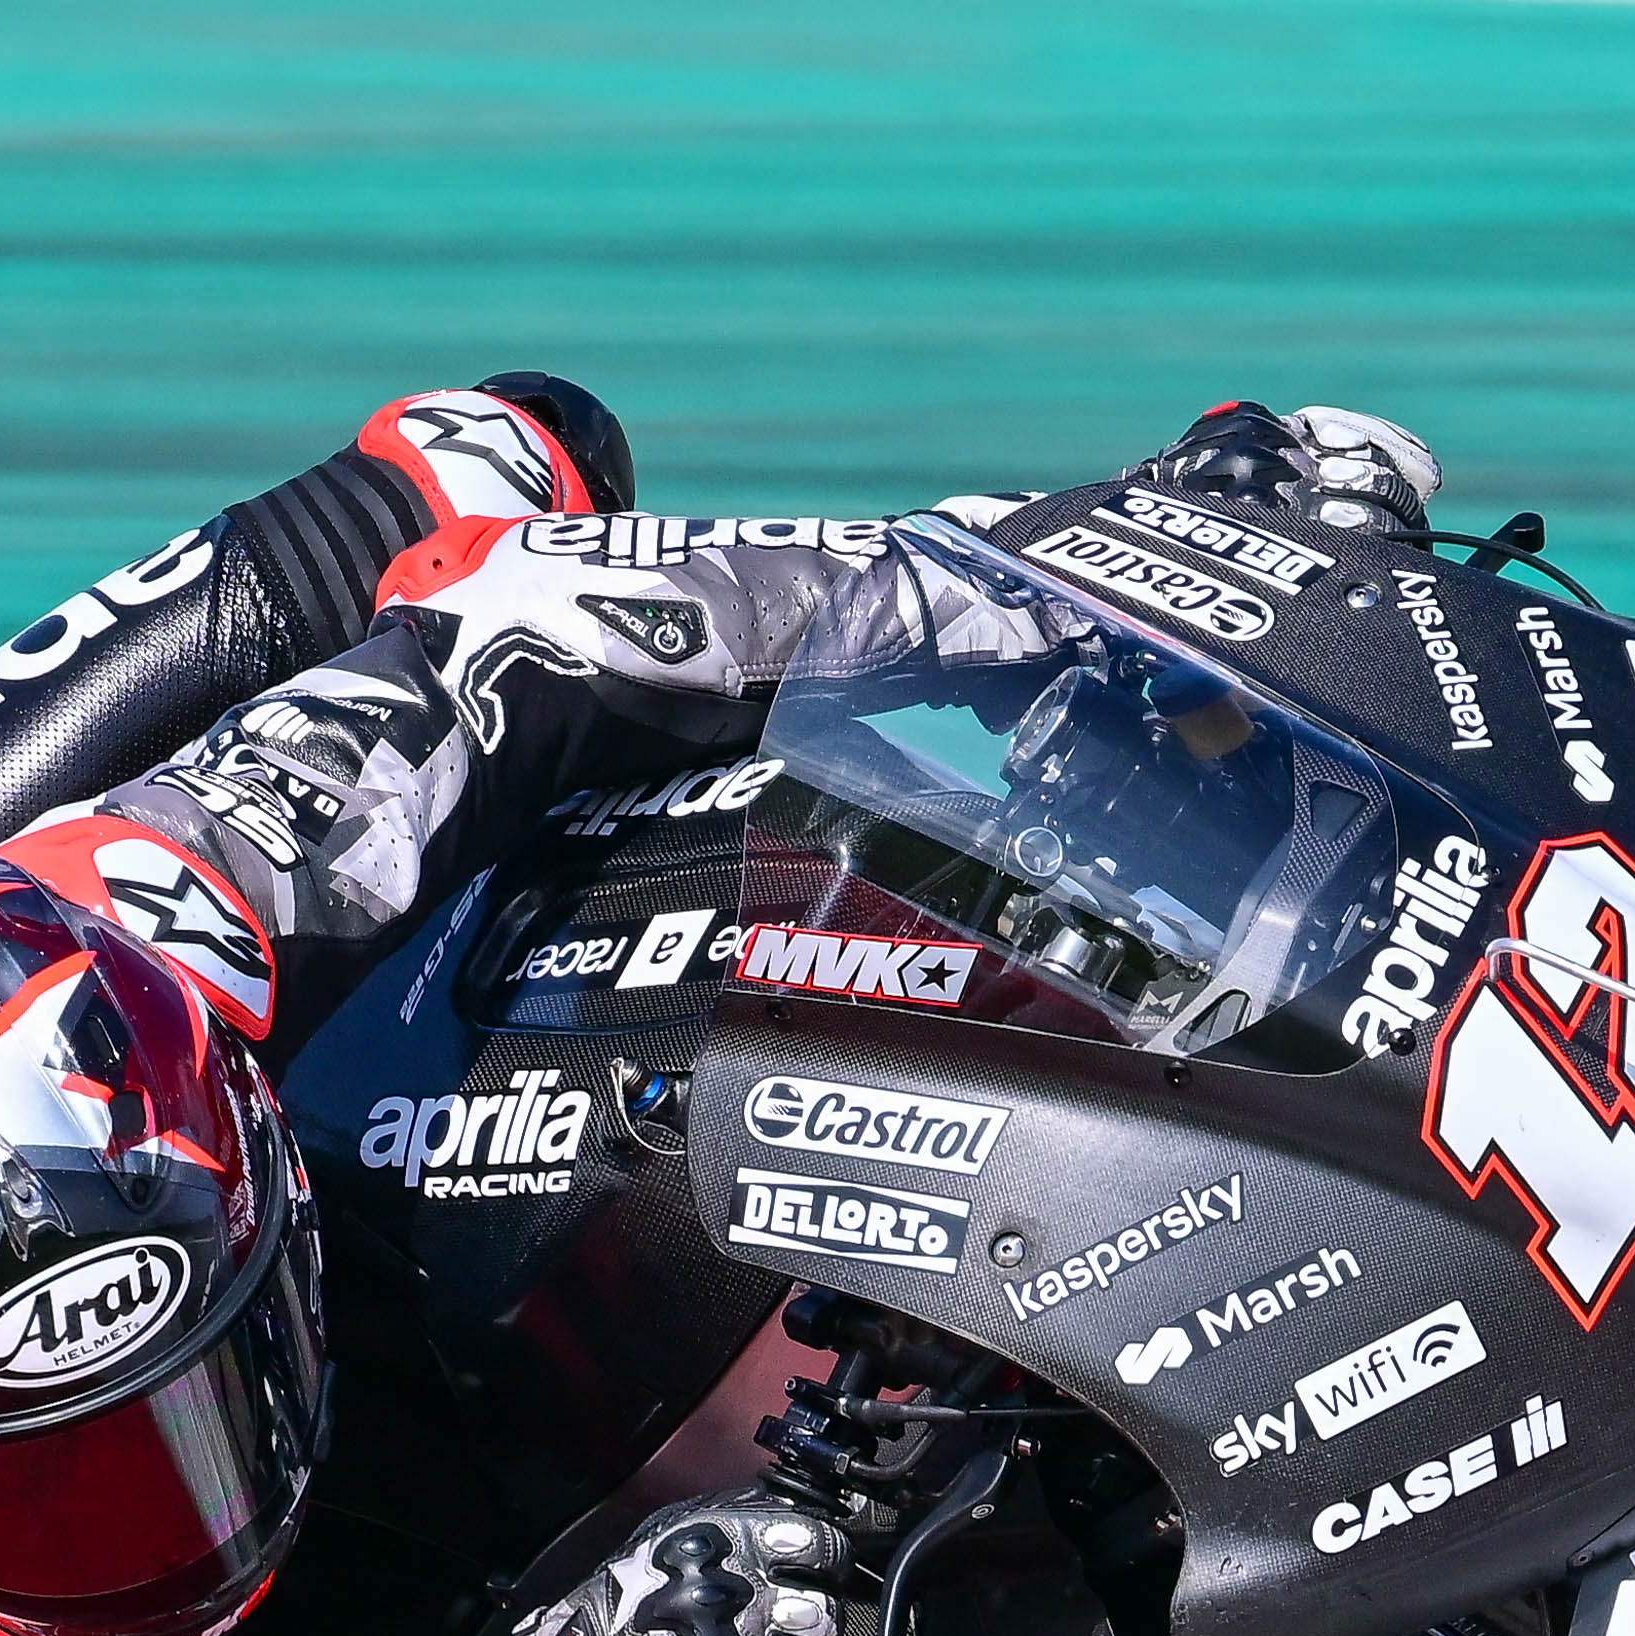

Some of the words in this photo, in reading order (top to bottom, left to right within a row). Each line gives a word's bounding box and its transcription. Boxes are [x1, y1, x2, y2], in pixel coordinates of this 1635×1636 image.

[1059, 530, 1215, 609] Castrol
[1122, 495, 1316, 580] DELLORTO
[1391, 569, 1493, 751] kaspersky
[1516, 607, 1592, 729] Marsh
[546, 756, 786, 836] aprilia
[505, 936, 627, 983] racer
[744, 928, 921, 996] MVK
[1342, 835, 1489, 1059] aprilia
[360, 1070, 591, 1187] aprilia
[802, 1096, 992, 1163] Castrol
[423, 1170, 573, 1198] RACING
[743, 1184, 949, 1254] DELLORTO
[1002, 1174, 1243, 1321] kaspersky
[1195, 1245, 1362, 1348] Marsh
[53, 1320, 141, 1367] HELMET
[1212, 1402, 1298, 1476] sky
[1314, 1345, 1405, 1418] wifi
[1312, 1434, 1499, 1554] CASE
